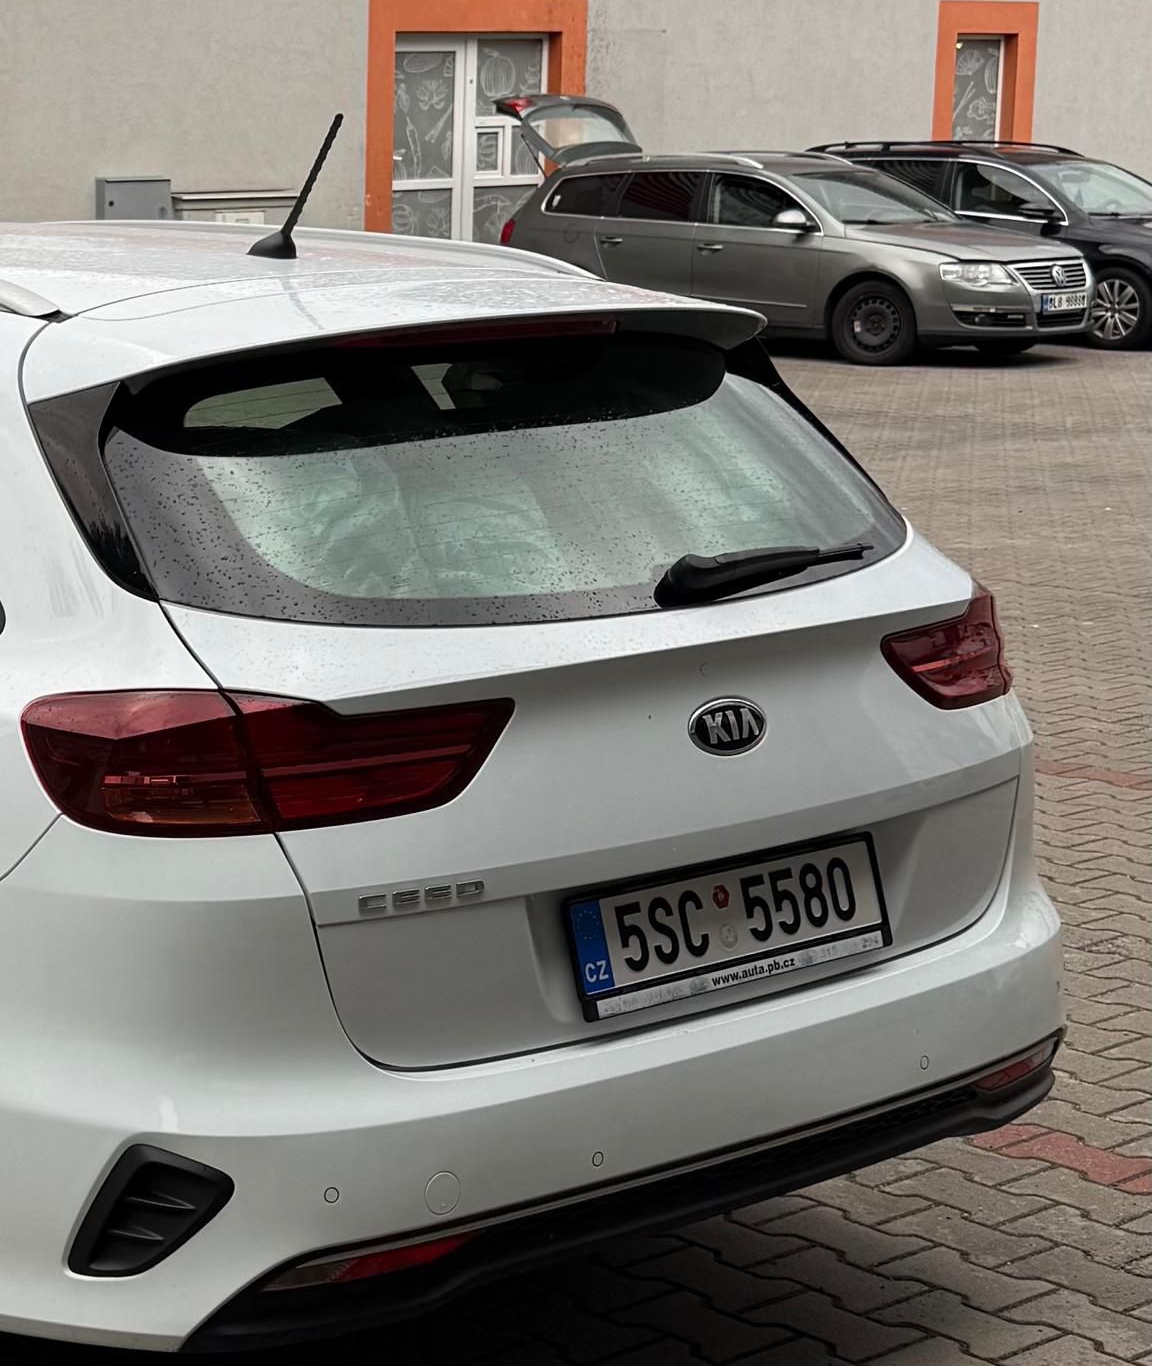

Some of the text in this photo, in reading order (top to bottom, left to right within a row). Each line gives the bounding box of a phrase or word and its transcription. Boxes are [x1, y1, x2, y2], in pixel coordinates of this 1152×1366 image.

[702, 707, 759, 744] KIA
[358, 880, 485, 911] CEED
[584, 857, 856, 984] CZ 5SC 5580
[711, 958, 796, 987] www.auta.pb.cz
